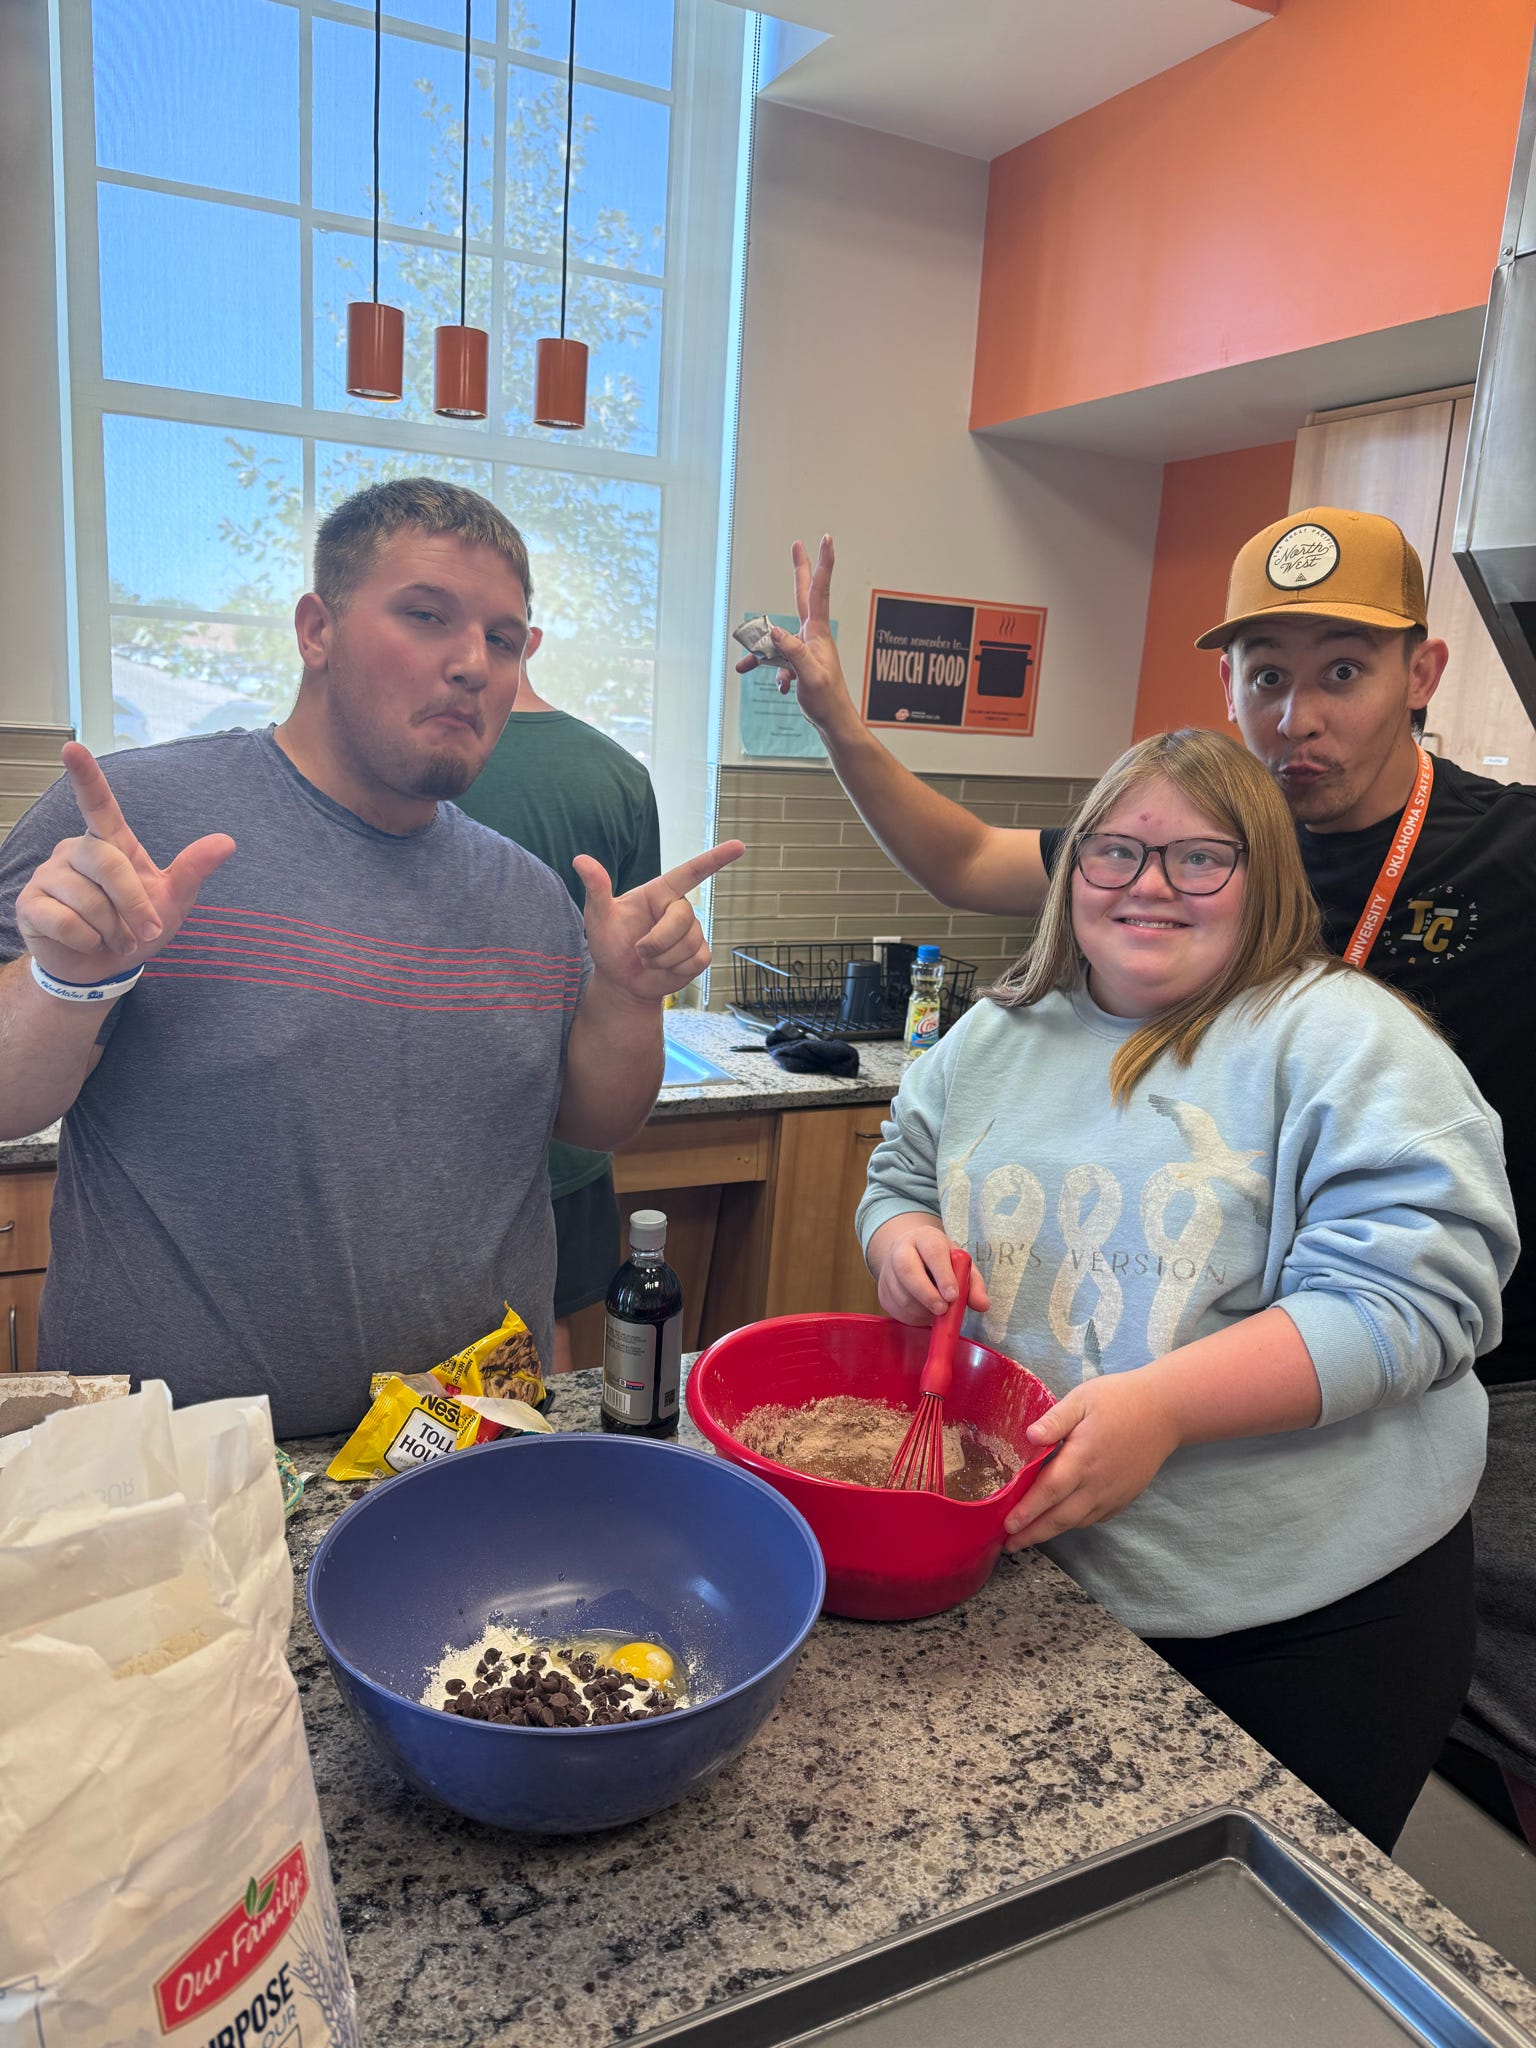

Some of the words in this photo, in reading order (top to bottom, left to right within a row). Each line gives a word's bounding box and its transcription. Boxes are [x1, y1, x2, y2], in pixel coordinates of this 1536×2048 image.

[1273, 542, 1329, 565] North
[1280, 556, 1322, 574] West
[876, 629, 908, 645] Please
[910, 635, 950, 649] remember
[875, 648, 924, 684] WATCH
[927, 652, 965, 687] FOOD
[1347, 894, 1386, 966] UNIVERSITY
[1386, 809, 1422, 878] OKLAHOMA
[1414, 771, 1430, 807] STATE
[1071, 1249, 1227, 1285] VERSION
[398, 1434, 438, 1462] HOU
[421, 1422, 455, 1453] TOLL
[175, 1950, 229, 2012] Our
[232, 1871, 303, 1967] Family
[200, 1961, 294, 2048] RPOSE
